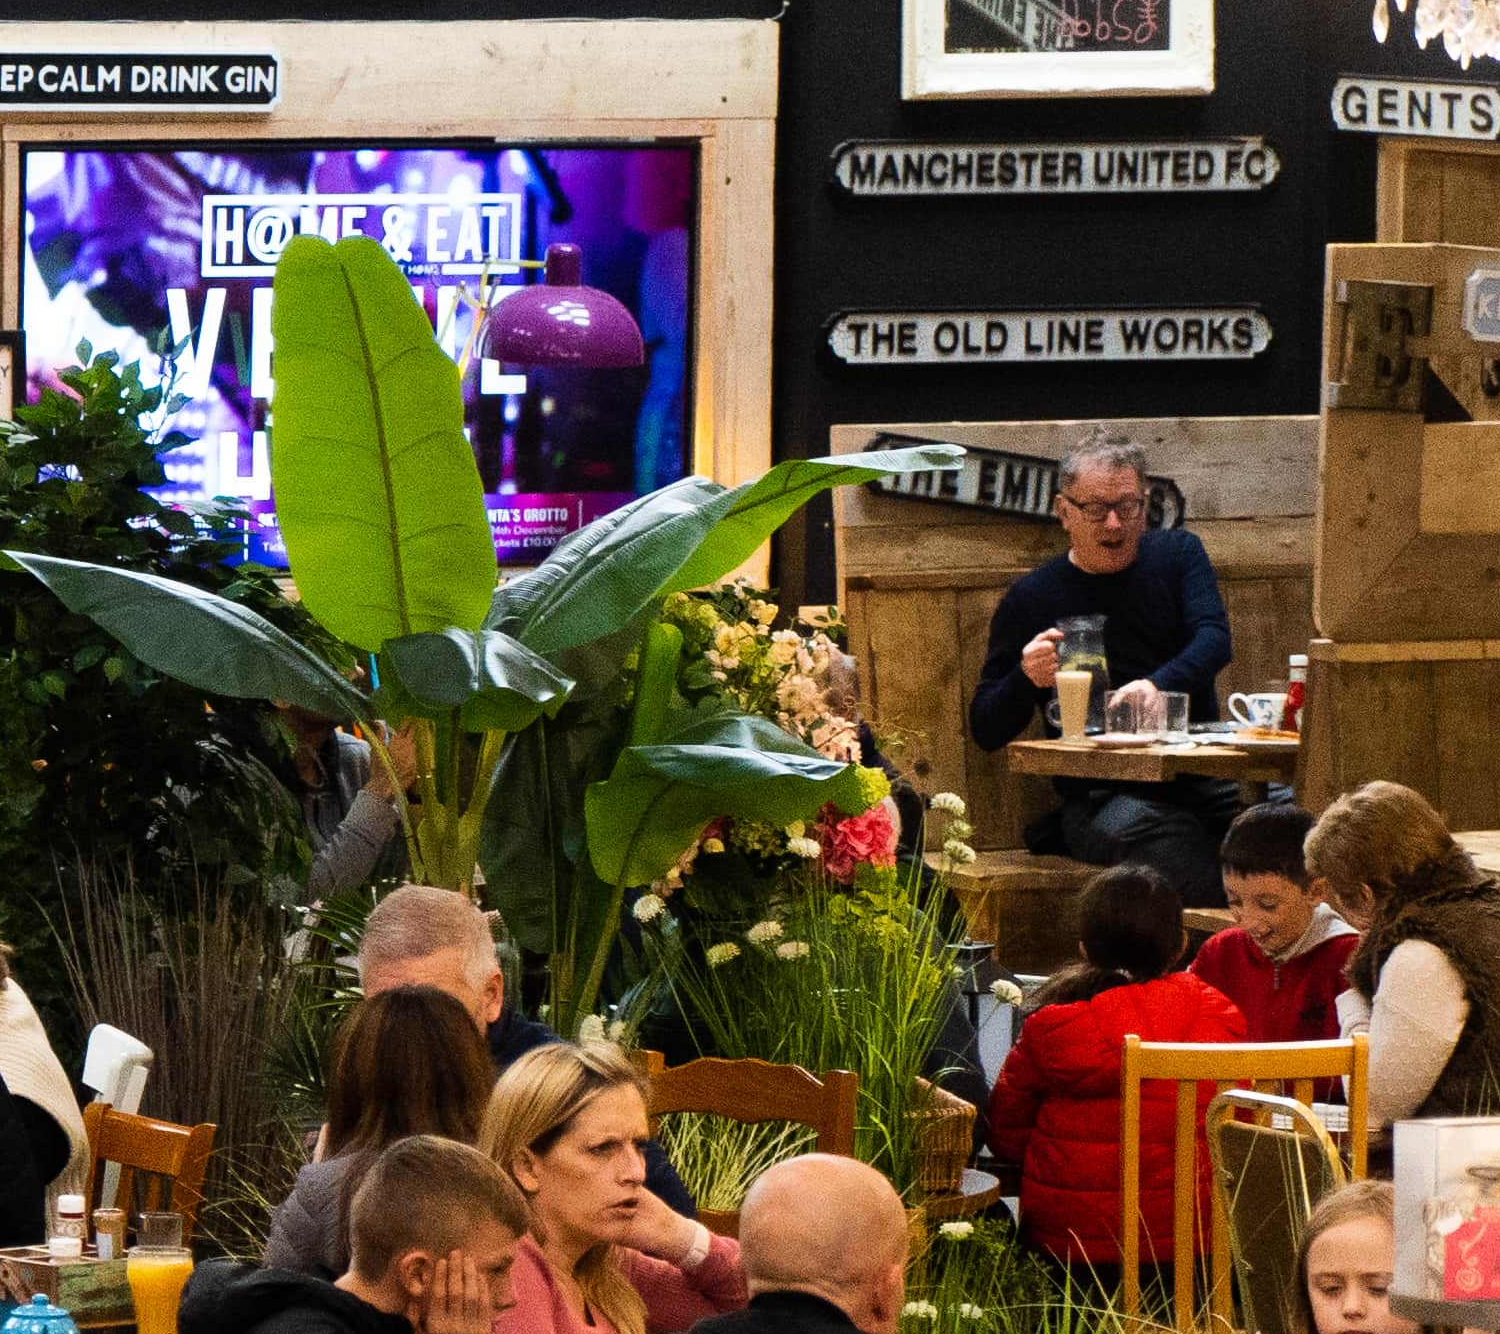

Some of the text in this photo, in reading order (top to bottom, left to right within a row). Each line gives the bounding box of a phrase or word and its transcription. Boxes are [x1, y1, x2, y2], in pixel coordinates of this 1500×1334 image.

[38, 64, 121, 93] CALM
[130, 64, 220, 93] DRINK
[225, 64, 274, 93] GIN
[1341, 83, 1494, 133] GENTS
[849, 148, 1267, 187] MANCHESTER UNITED FC
[427, 205, 508, 263] EAT
[848, 317, 1254, 356] THE OLD LINE WORKS
[486, 508, 568, 523] NTA'S GROTTO
